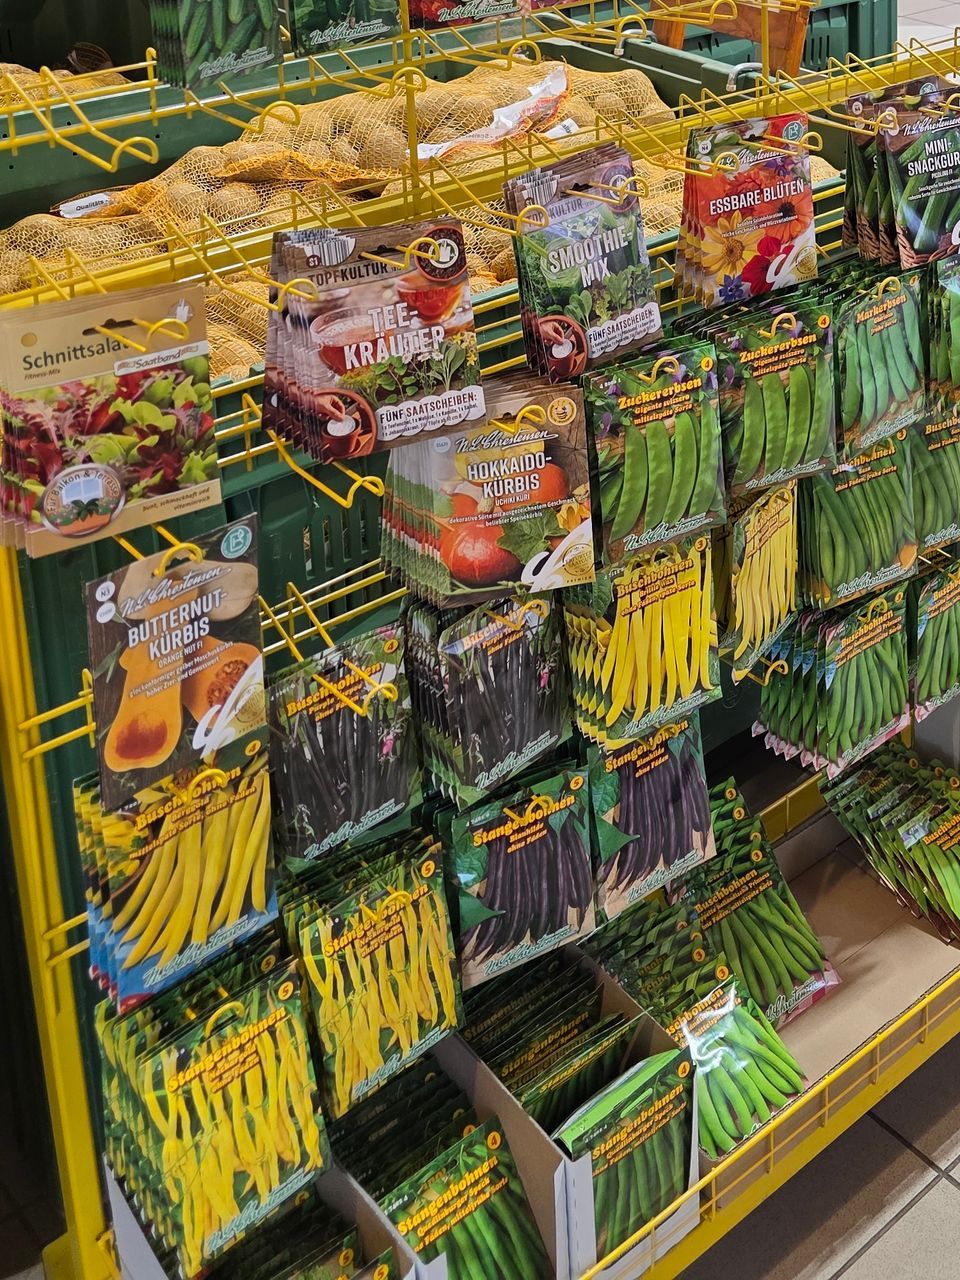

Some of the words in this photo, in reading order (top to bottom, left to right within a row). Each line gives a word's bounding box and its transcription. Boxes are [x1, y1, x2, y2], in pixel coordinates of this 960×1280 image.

[924, 138, 952, 156] MINI-
[710, 189, 761, 216] ESSBARE
[763, 180, 804, 201] BLÜTEN
[548, 226, 634, 274] SMOOTHIE-
[581, 256, 611, 288] MIX
[368, 302, 418, 333] TEE-
[855, 293, 907, 324] Markerbsen
[588, 328, 607, 343] FÜNF
[607, 309, 655, 335] SAATSCHEIBEN:
[21, 337, 131, 371] Schnittsalat
[135, 350, 183, 369] Saatband
[343, 326, 445, 370] KRÄUTER
[739, 333, 818, 364] Zuckererbsen
[379, 408, 405, 424] FÜNF
[405, 392, 478, 416] SAATSCHEIBEN:
[618, 376, 702, 410] Zuckererbsen
[467, 451, 553, 482] HOKKAIDO-
[482, 474, 541, 499] KÜRBIS
[495, 496, 514, 506] UCHIKI
[515, 493, 530, 502] KURI
[616, 557, 694, 598] Buschbohnen
[127, 588, 228, 648] BUTTERNUT-
[841, 610, 894, 647] Buschbohnen
[149, 617, 210, 661] KÜRBIS
[158, 649, 184, 668] ORANGE
[184, 645, 197, 657] NUT
[695, 869, 757, 913] Buschbohnen
[167, 1008, 286, 1093] Stangenbohnen
[592, 1084, 684, 1160] Stangenbohnen
[398, 1155, 498, 1236] Stangenbohnen
